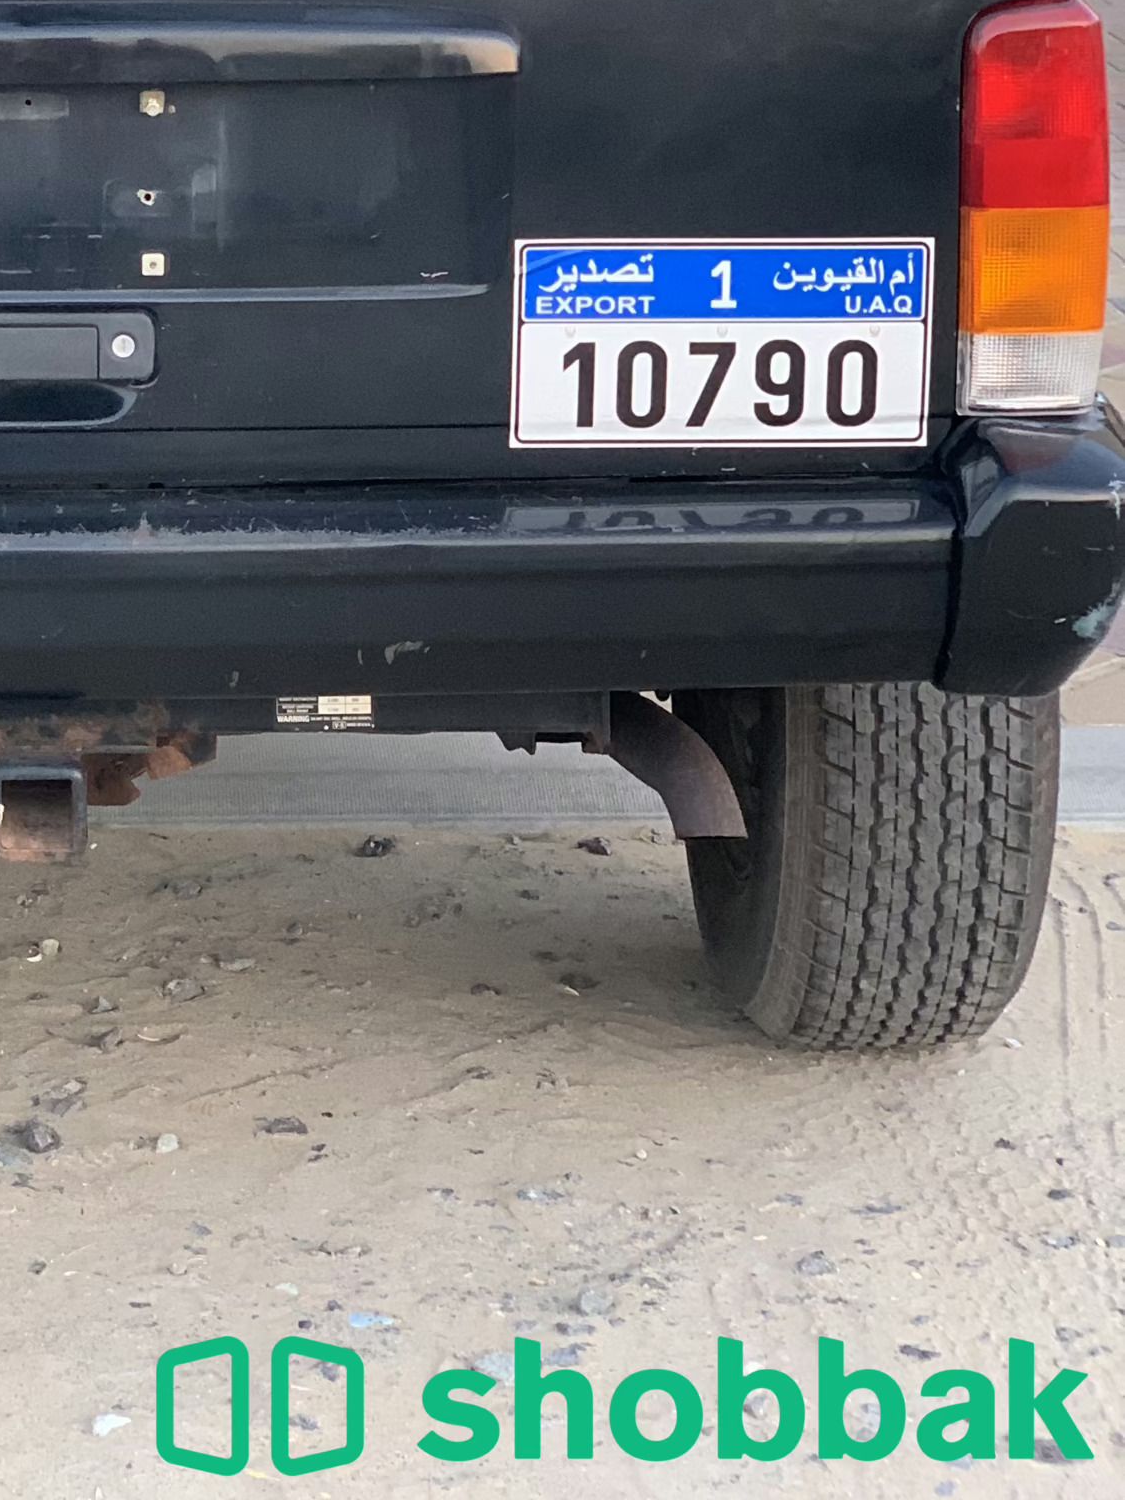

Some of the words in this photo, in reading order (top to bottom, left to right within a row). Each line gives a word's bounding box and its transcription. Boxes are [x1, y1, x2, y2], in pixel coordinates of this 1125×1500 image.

[538, 253, 655, 293] تصدير
[710, 260, 738, 310] 1
[773, 256, 885, 292] القيوين
[889, 252, 915, 296] أم
[535, 295, 656, 315] EXPORT
[844, 295, 913, 315] U.A.Q
[561, 339, 878, 429] 10790
